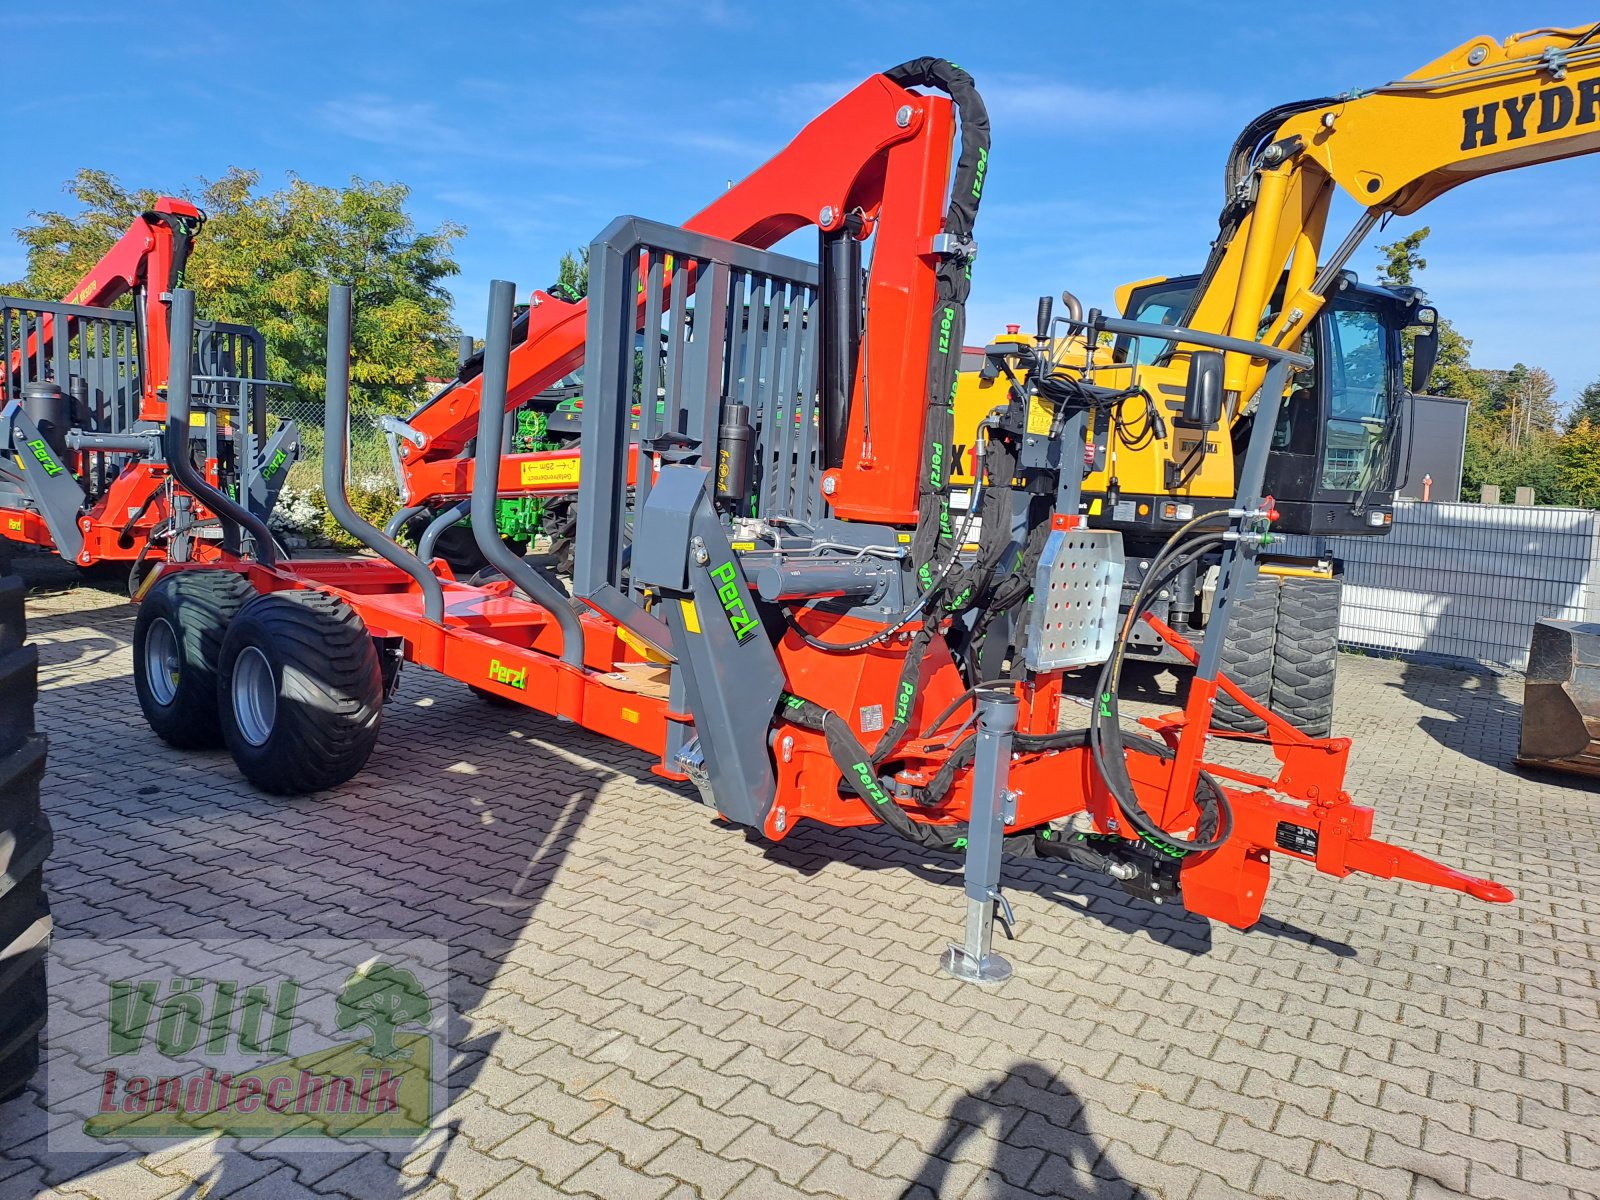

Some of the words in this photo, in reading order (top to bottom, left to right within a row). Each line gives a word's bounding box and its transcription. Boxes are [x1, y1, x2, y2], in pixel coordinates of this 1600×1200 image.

[1460, 77, 1600, 151] HYDR
[971, 147, 988, 199] Perzl
[938, 307, 956, 354] Perzl
[28, 439, 64, 477] Perzl
[262, 448, 287, 480] Perzl
[930, 441, 943, 489] Perzl
[710, 560, 760, 641] Perzl
[489, 658, 526, 690] Perzl
[852, 762, 889, 805] Perzl
